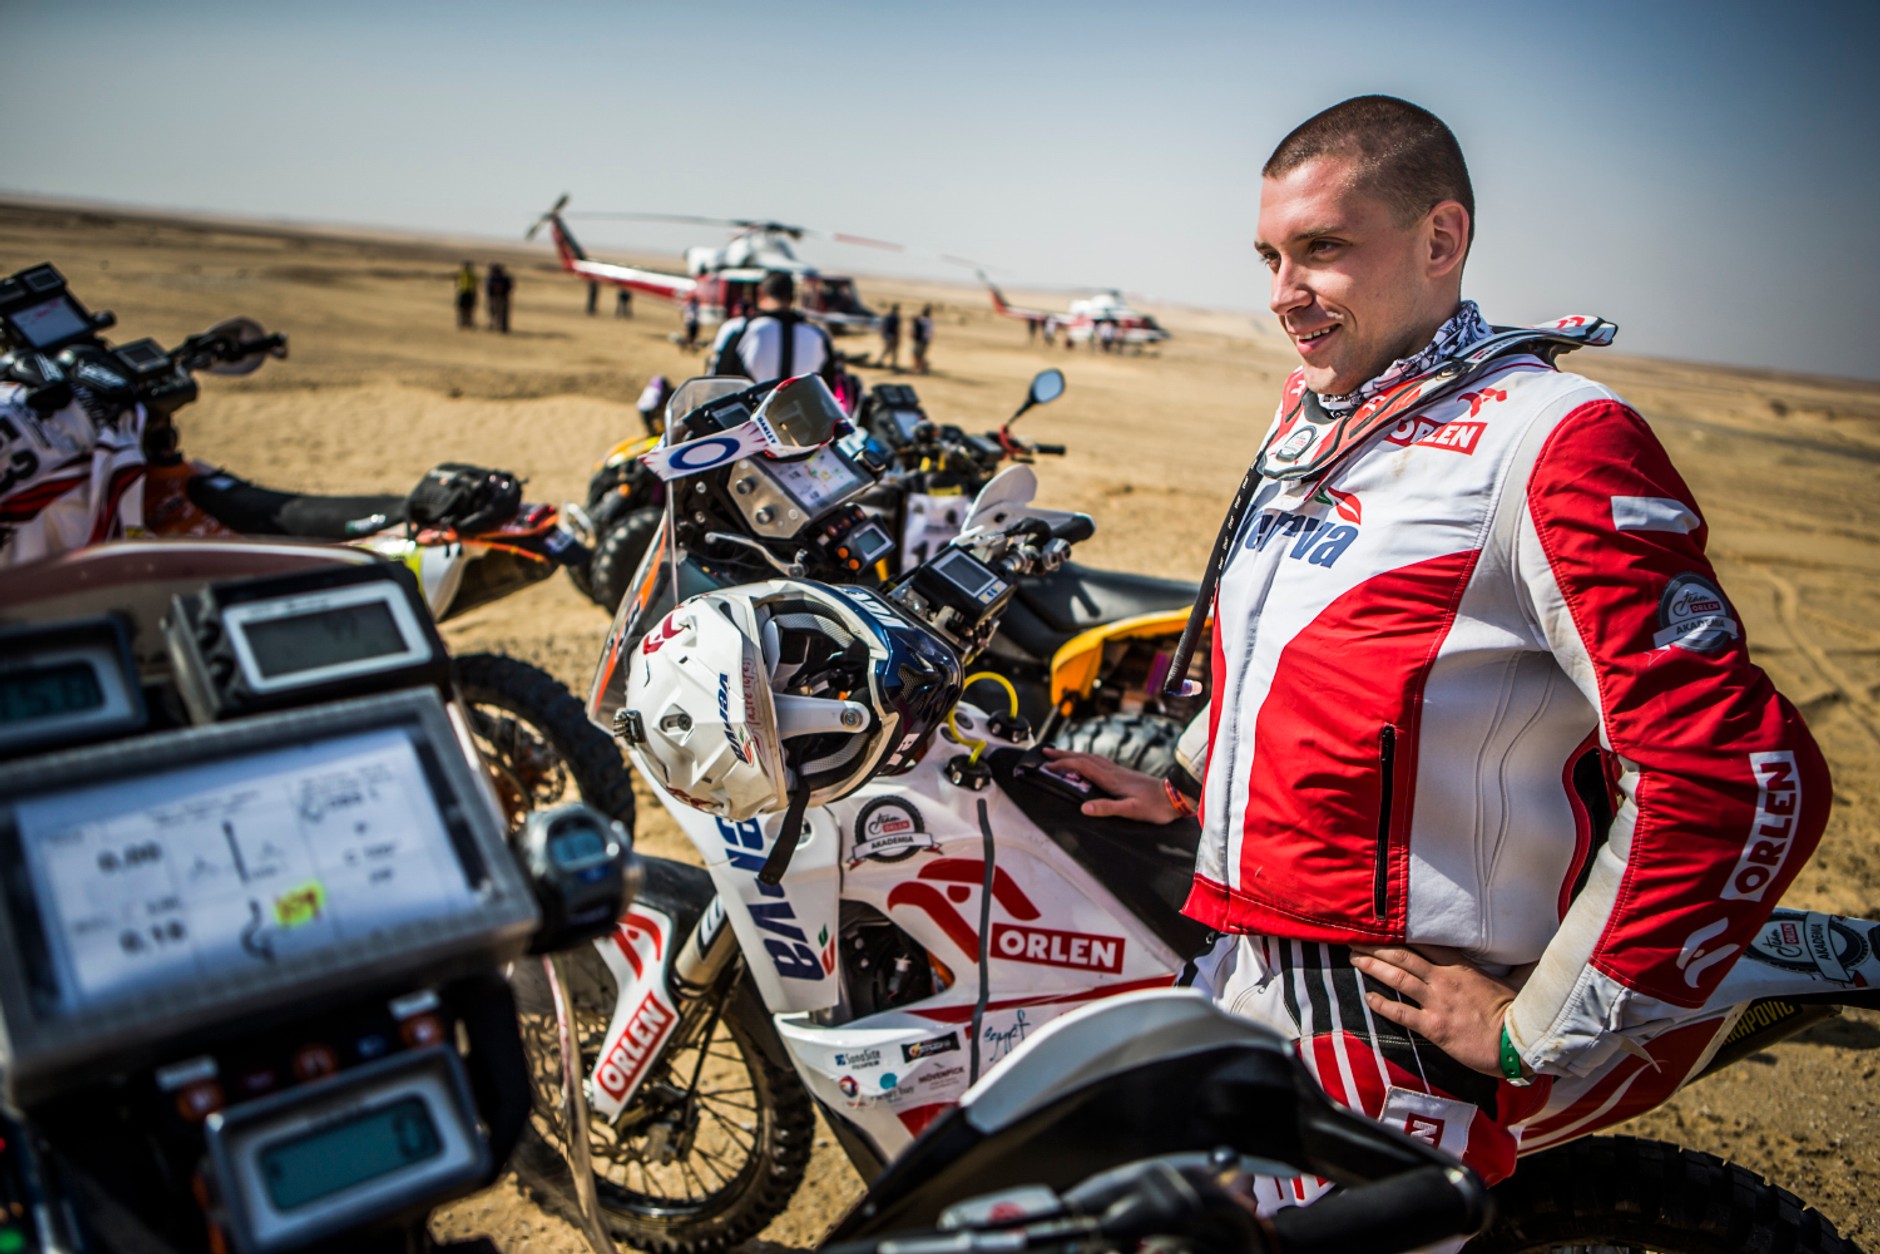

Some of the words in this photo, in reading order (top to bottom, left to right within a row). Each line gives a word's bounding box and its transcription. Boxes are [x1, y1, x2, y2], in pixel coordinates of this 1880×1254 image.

[1390, 420, 1479, 449] ORLEN
[1692, 603, 1719, 612] ORLEN
[871, 835, 914, 849] AKADEMIA
[1734, 761, 1797, 895] ORLEN
[715, 816, 825, 981] erva
[999, 930, 1117, 968] ORLEN
[1810, 924, 1832, 961] AKADEMIA
[601, 997, 667, 1092] ORLEN
